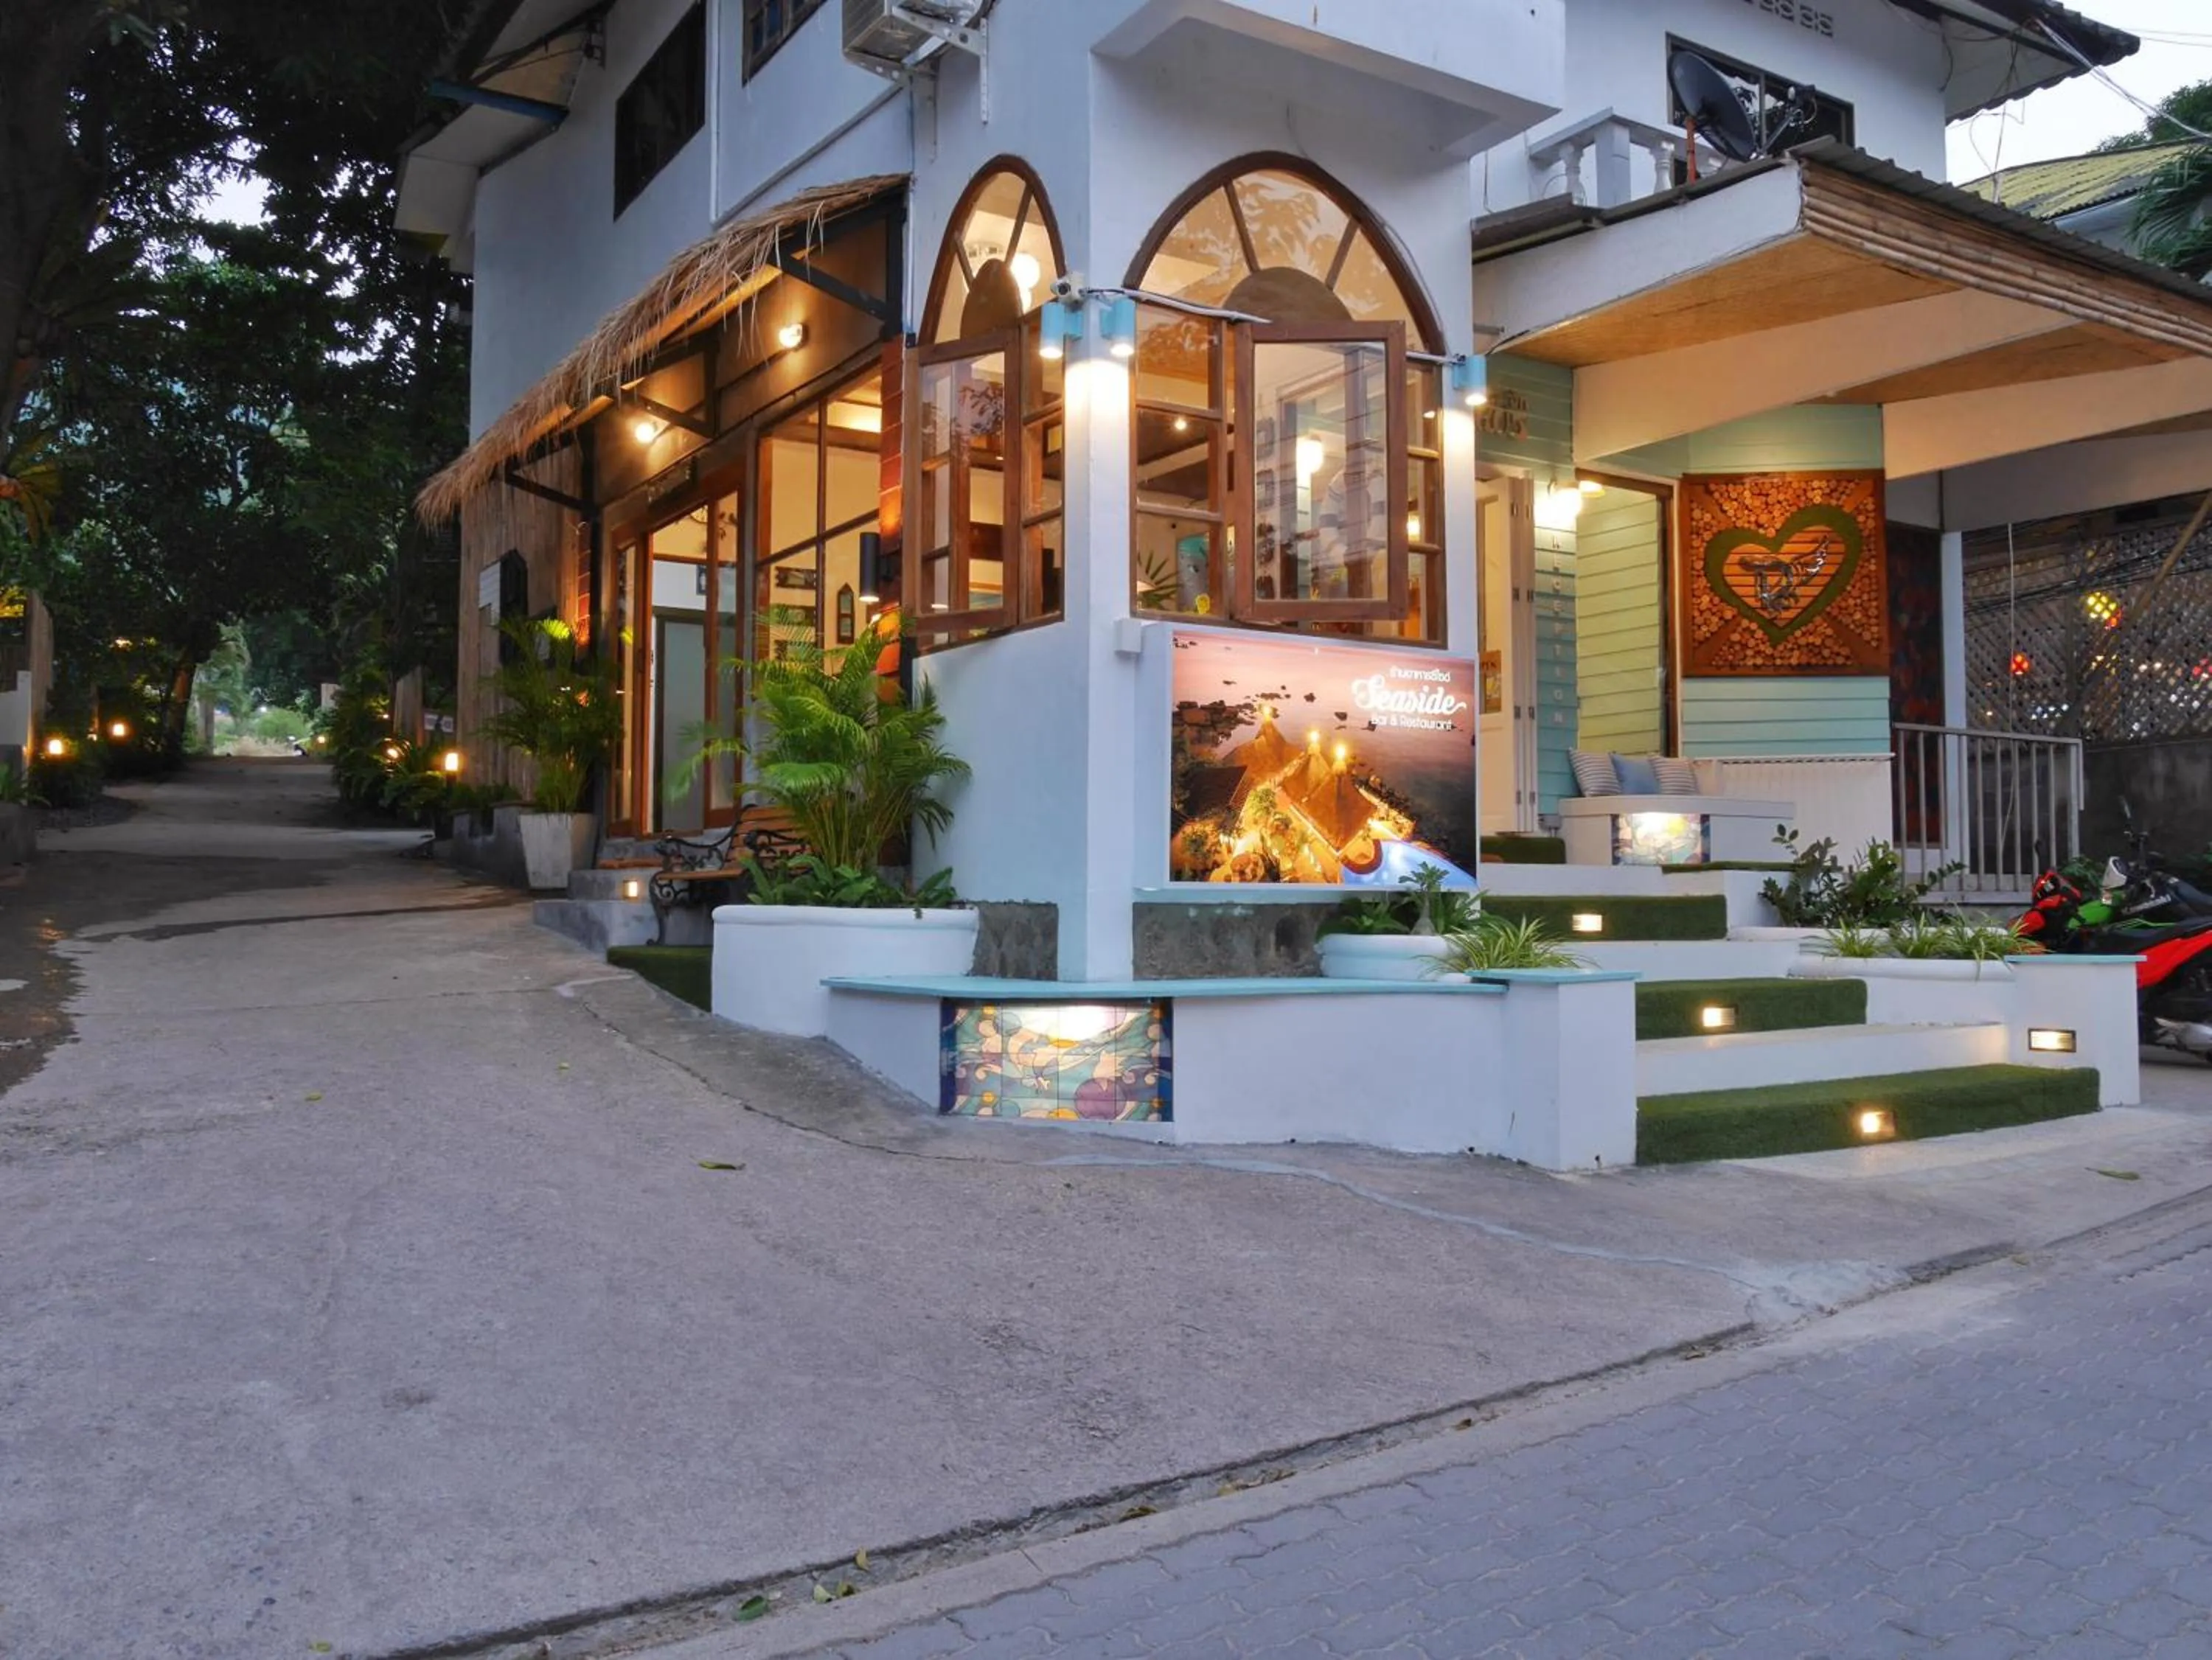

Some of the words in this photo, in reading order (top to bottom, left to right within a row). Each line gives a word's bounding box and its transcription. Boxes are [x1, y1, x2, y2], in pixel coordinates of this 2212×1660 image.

[1351, 674, 1467, 714] Seaside
[1371, 712, 1388, 725] Bar
[1390, 714, 1397, 726] &
[1400, 715, 1452, 730] Restaurant
